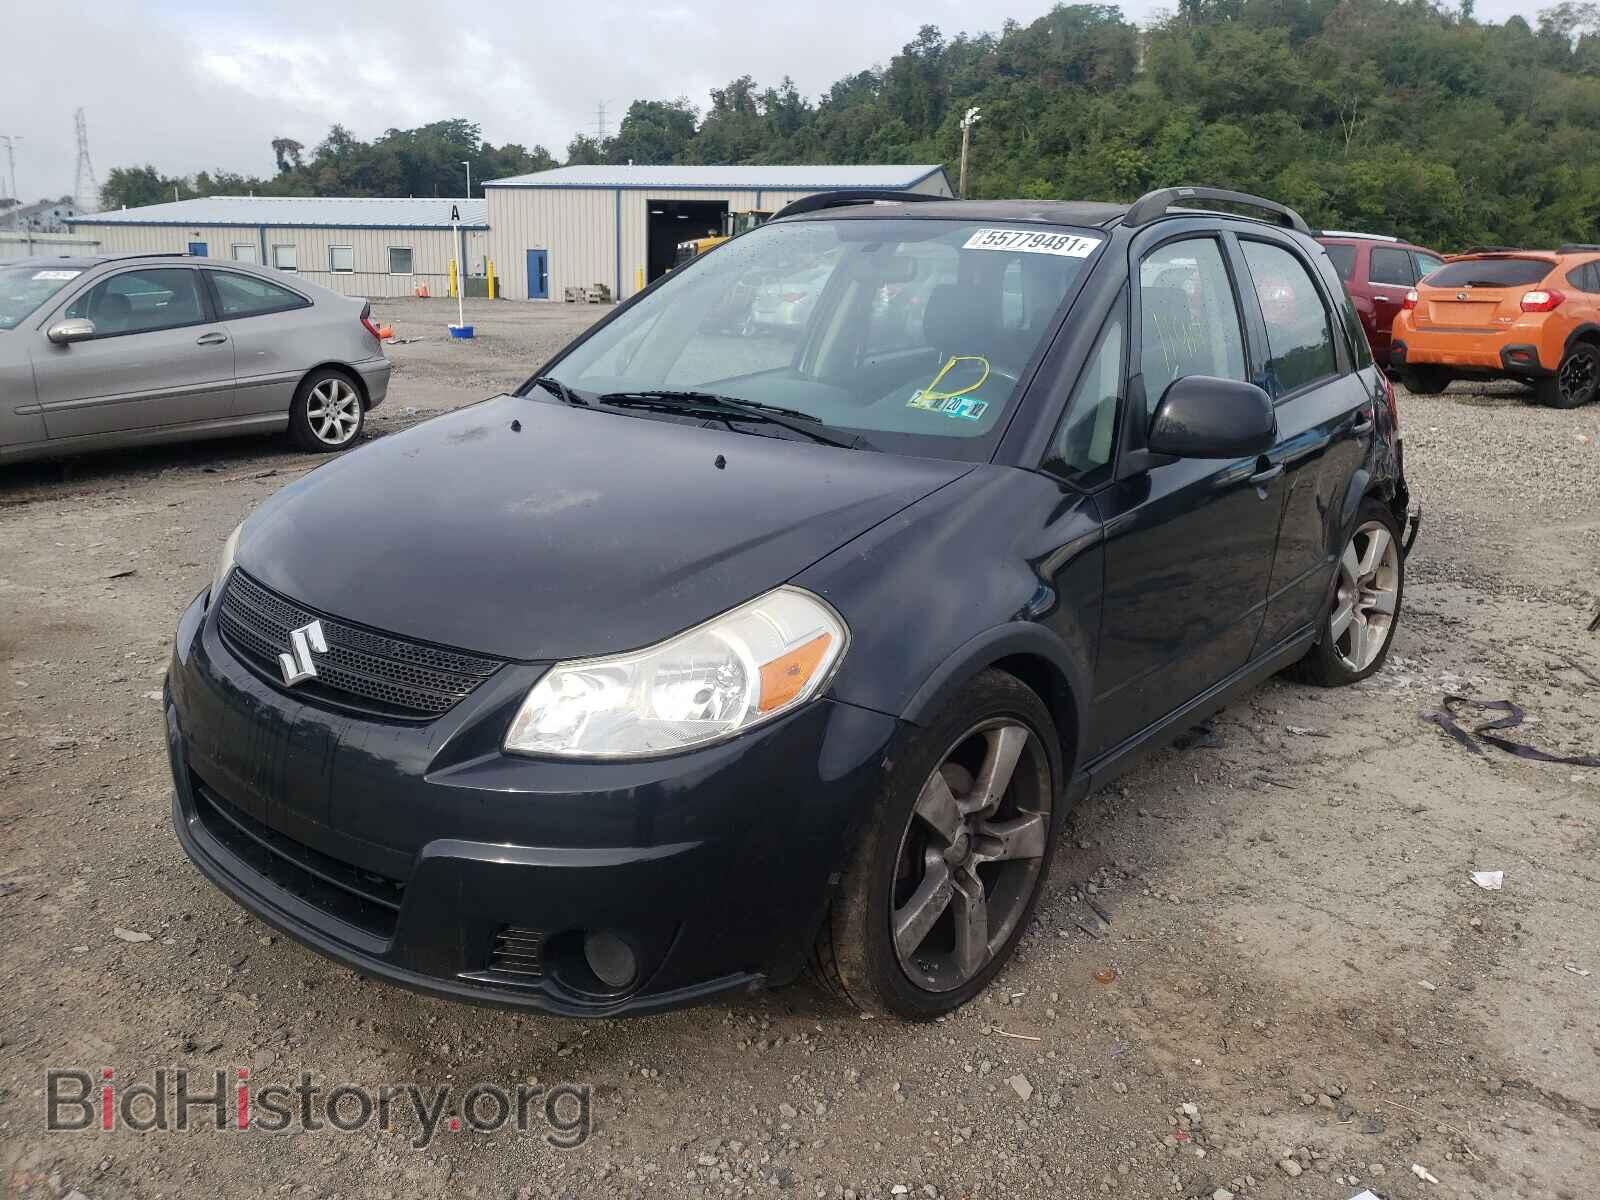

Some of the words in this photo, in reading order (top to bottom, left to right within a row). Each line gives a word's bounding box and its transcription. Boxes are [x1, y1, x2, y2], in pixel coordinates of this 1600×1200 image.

[451, 204, 460, 220] A
[982, 231, 1081, 252] 55779481
[1078, 243, 1090, 251] F
